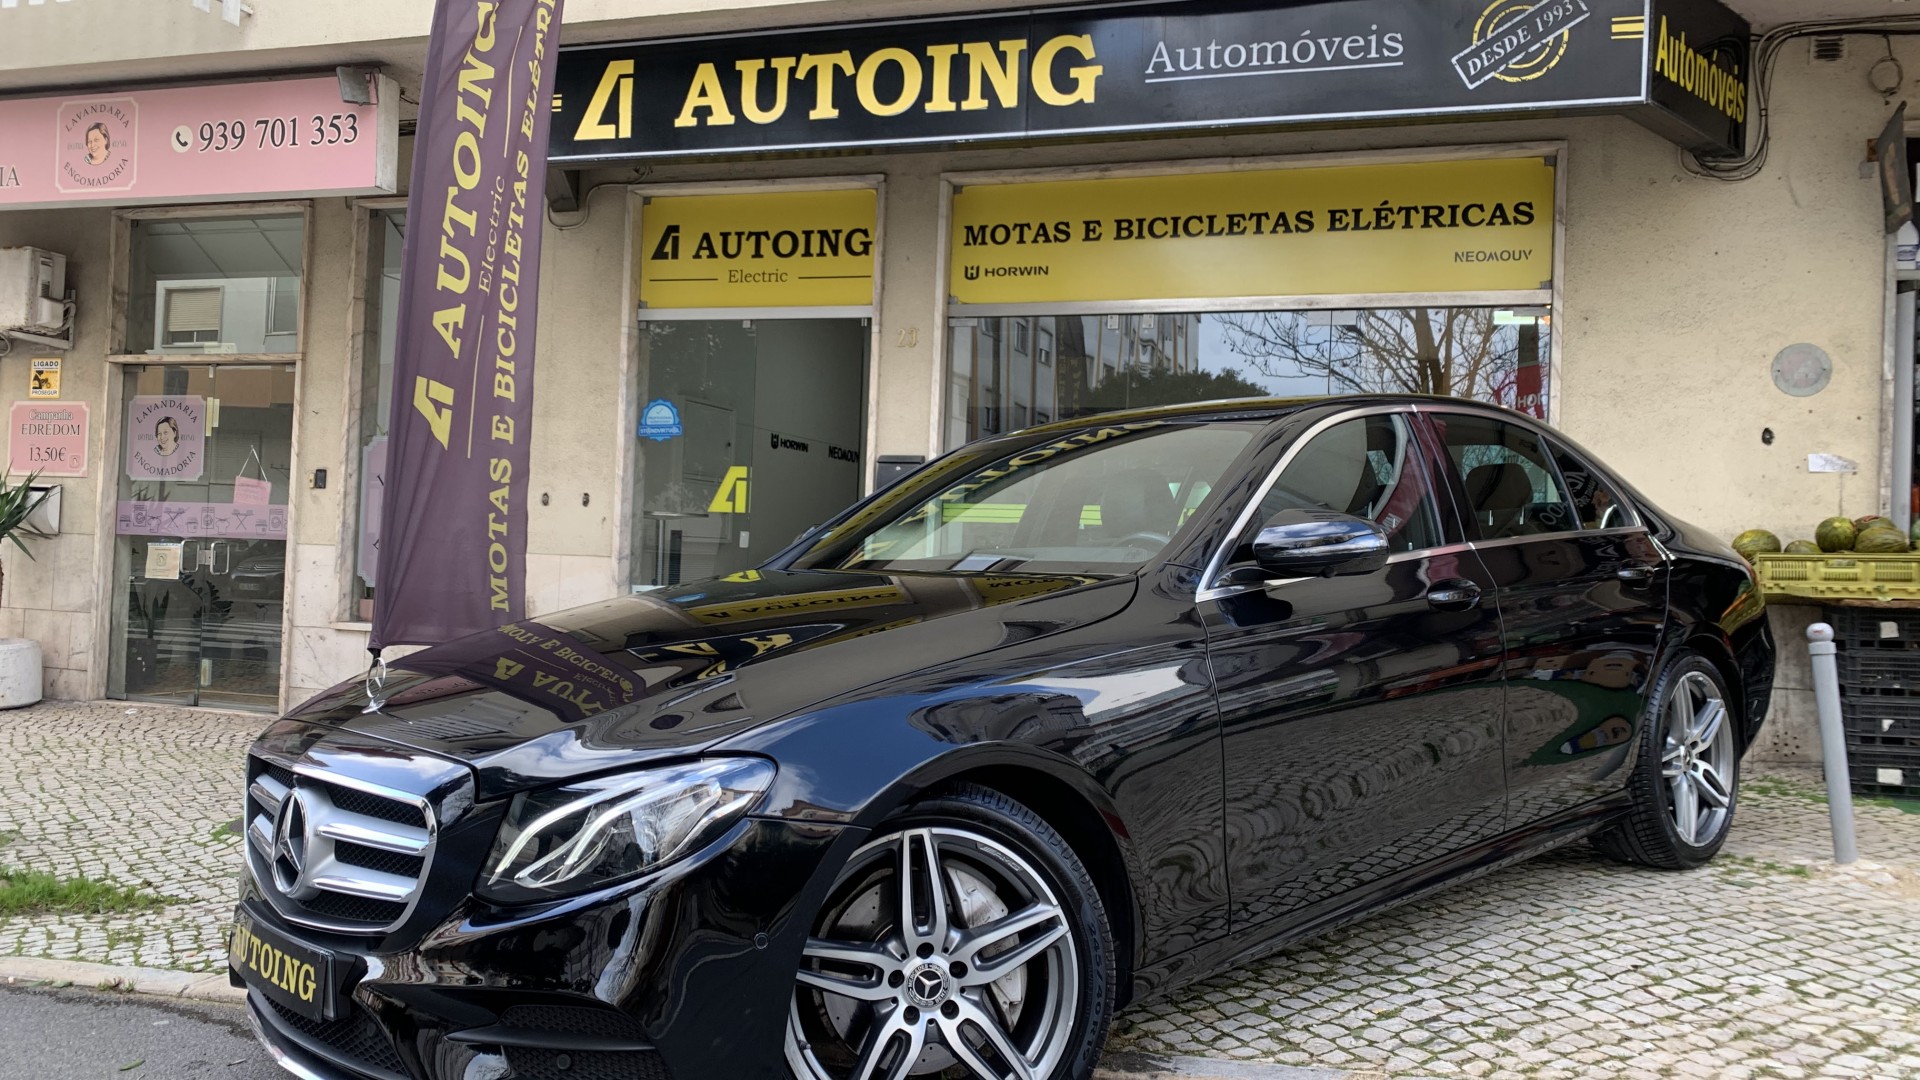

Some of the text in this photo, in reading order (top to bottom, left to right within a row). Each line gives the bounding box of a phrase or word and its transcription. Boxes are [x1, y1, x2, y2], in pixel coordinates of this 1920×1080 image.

[1144, 24, 1404, 74] Automóveis
[1466, 0, 1573, 76] DESDE 1993
[674, 33, 1104, 128] AUTOING
[1655, 14, 1745, 123] Automóveis
[65, 104, 130, 132] LAVANDARIA
[199, 113, 358, 152] 939 701 353
[63, 158, 129, 187] ENGOMADORIA
[478, 175, 505, 296] Electric
[963, 200, 1535, 246] MOTAS E BICICLETAS ELÉTRICAS
[692, 227, 873, 260] AUTOING
[1454, 249, 1533, 263] NEOMOUV
[493, 150, 530, 403] BICICLETAS
[727, 268, 789, 284] Electric
[984, 265, 1049, 278] HORWIN
[29, 408, 74, 424] Campanha
[136, 399, 198, 424] LAVANDARIA
[21, 423, 81, 436] EDREDOM
[491, 414, 515, 445] E
[29, 446, 67, 463] 13,50€
[780, 438, 809, 453] HORWIN
[134, 451, 196, 476] ENGOMADORIA
[488, 457, 513, 613] MOTAS
[232, 922, 317, 1003] AUTOING
